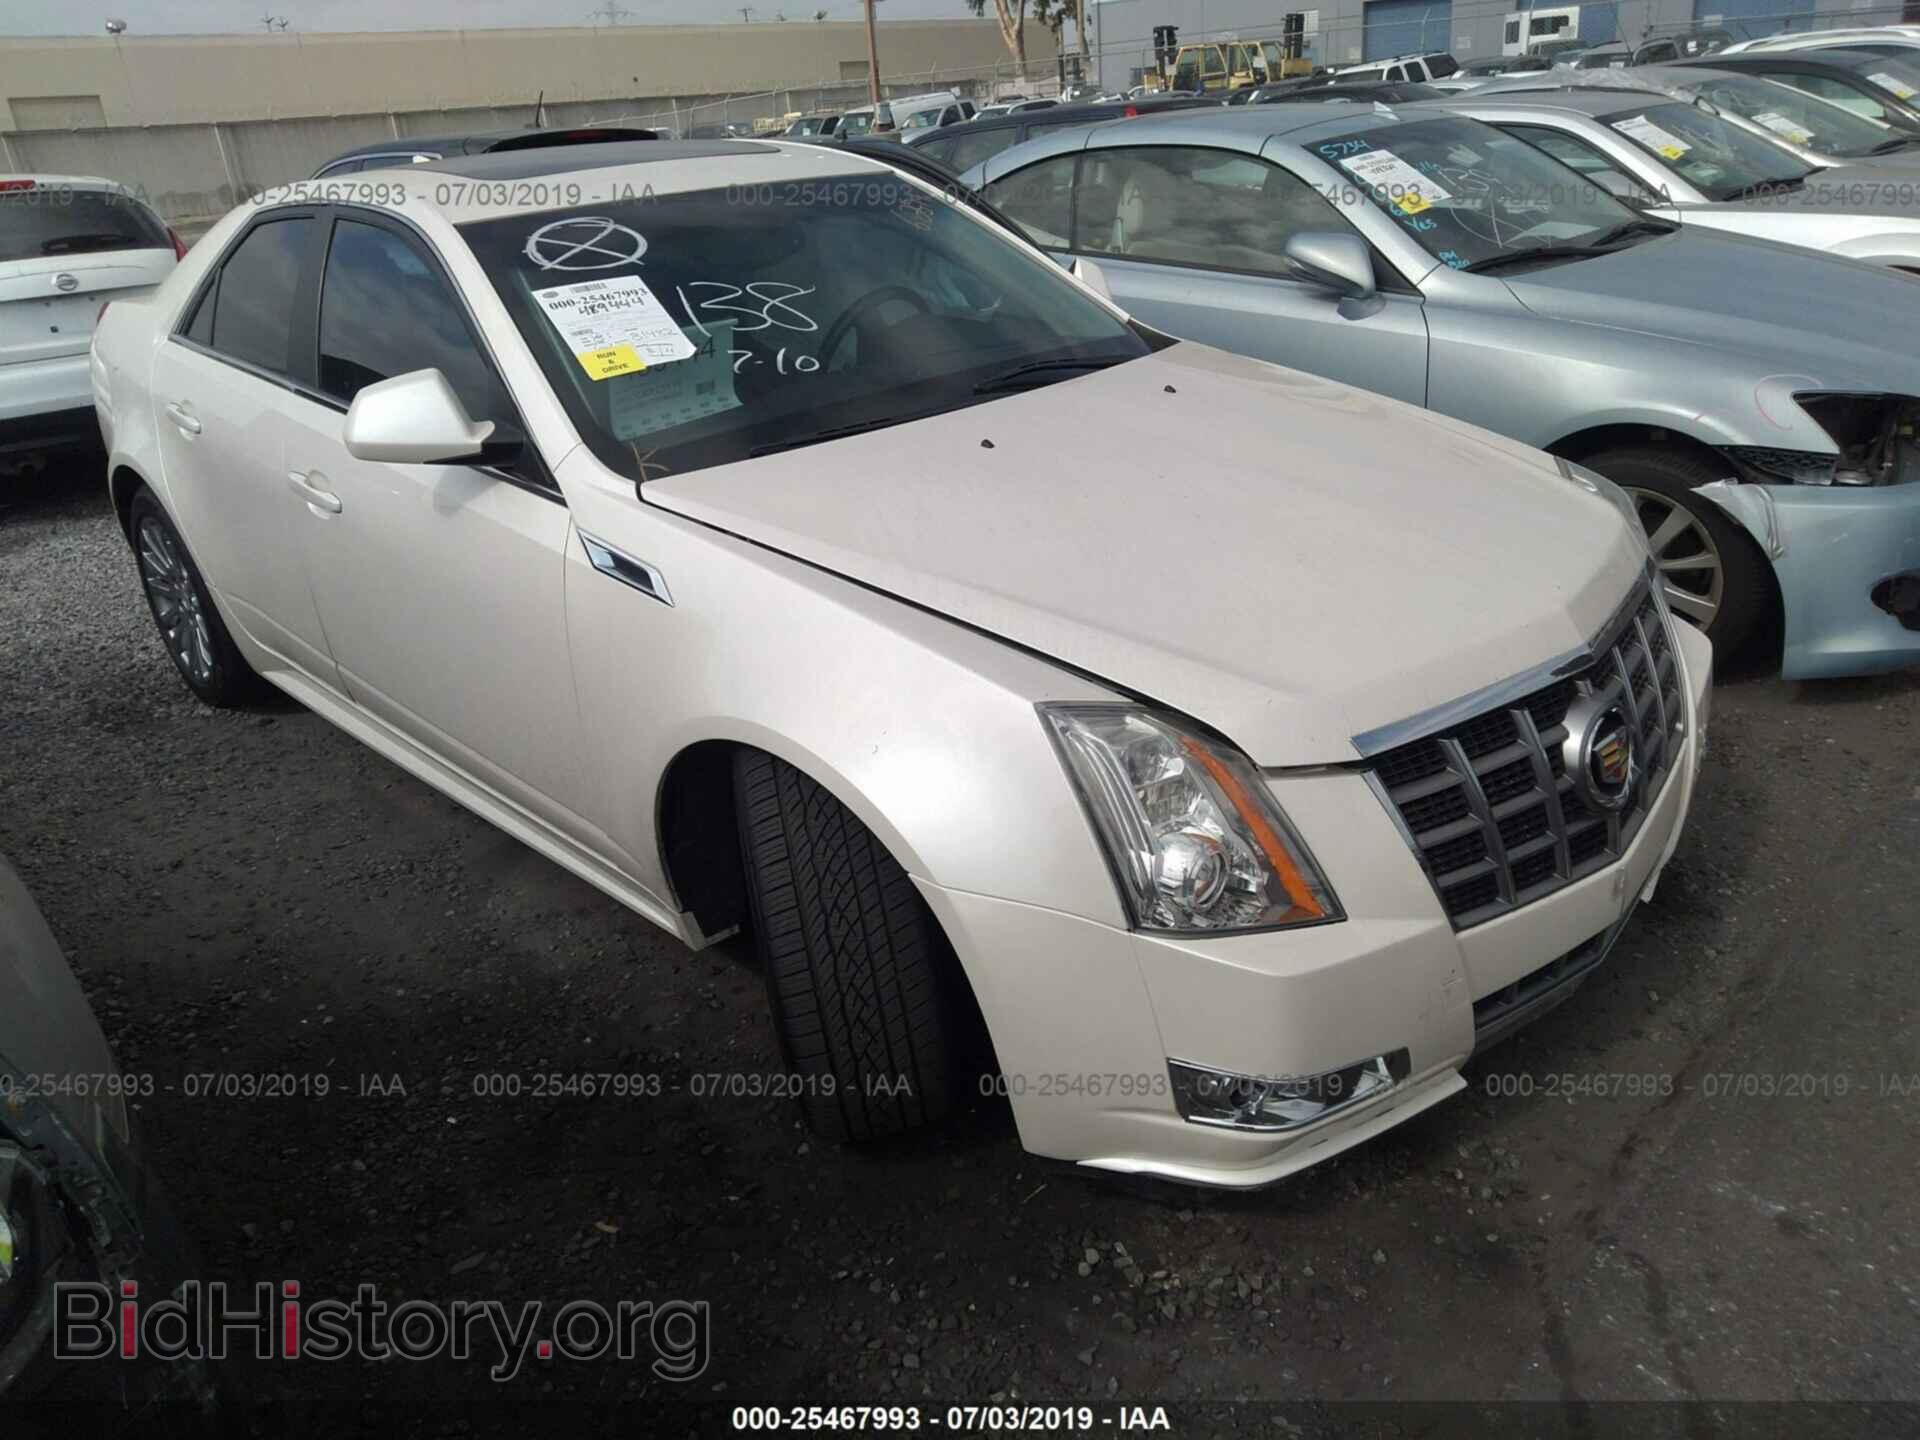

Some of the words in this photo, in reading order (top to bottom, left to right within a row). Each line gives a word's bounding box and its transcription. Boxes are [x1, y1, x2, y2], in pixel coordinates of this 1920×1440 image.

[676, 281, 819, 338] 138
[596, 350, 617, 360] RUN
[728, 347, 820, 375] 7-10
[601, 362, 630, 374] DRIVE
